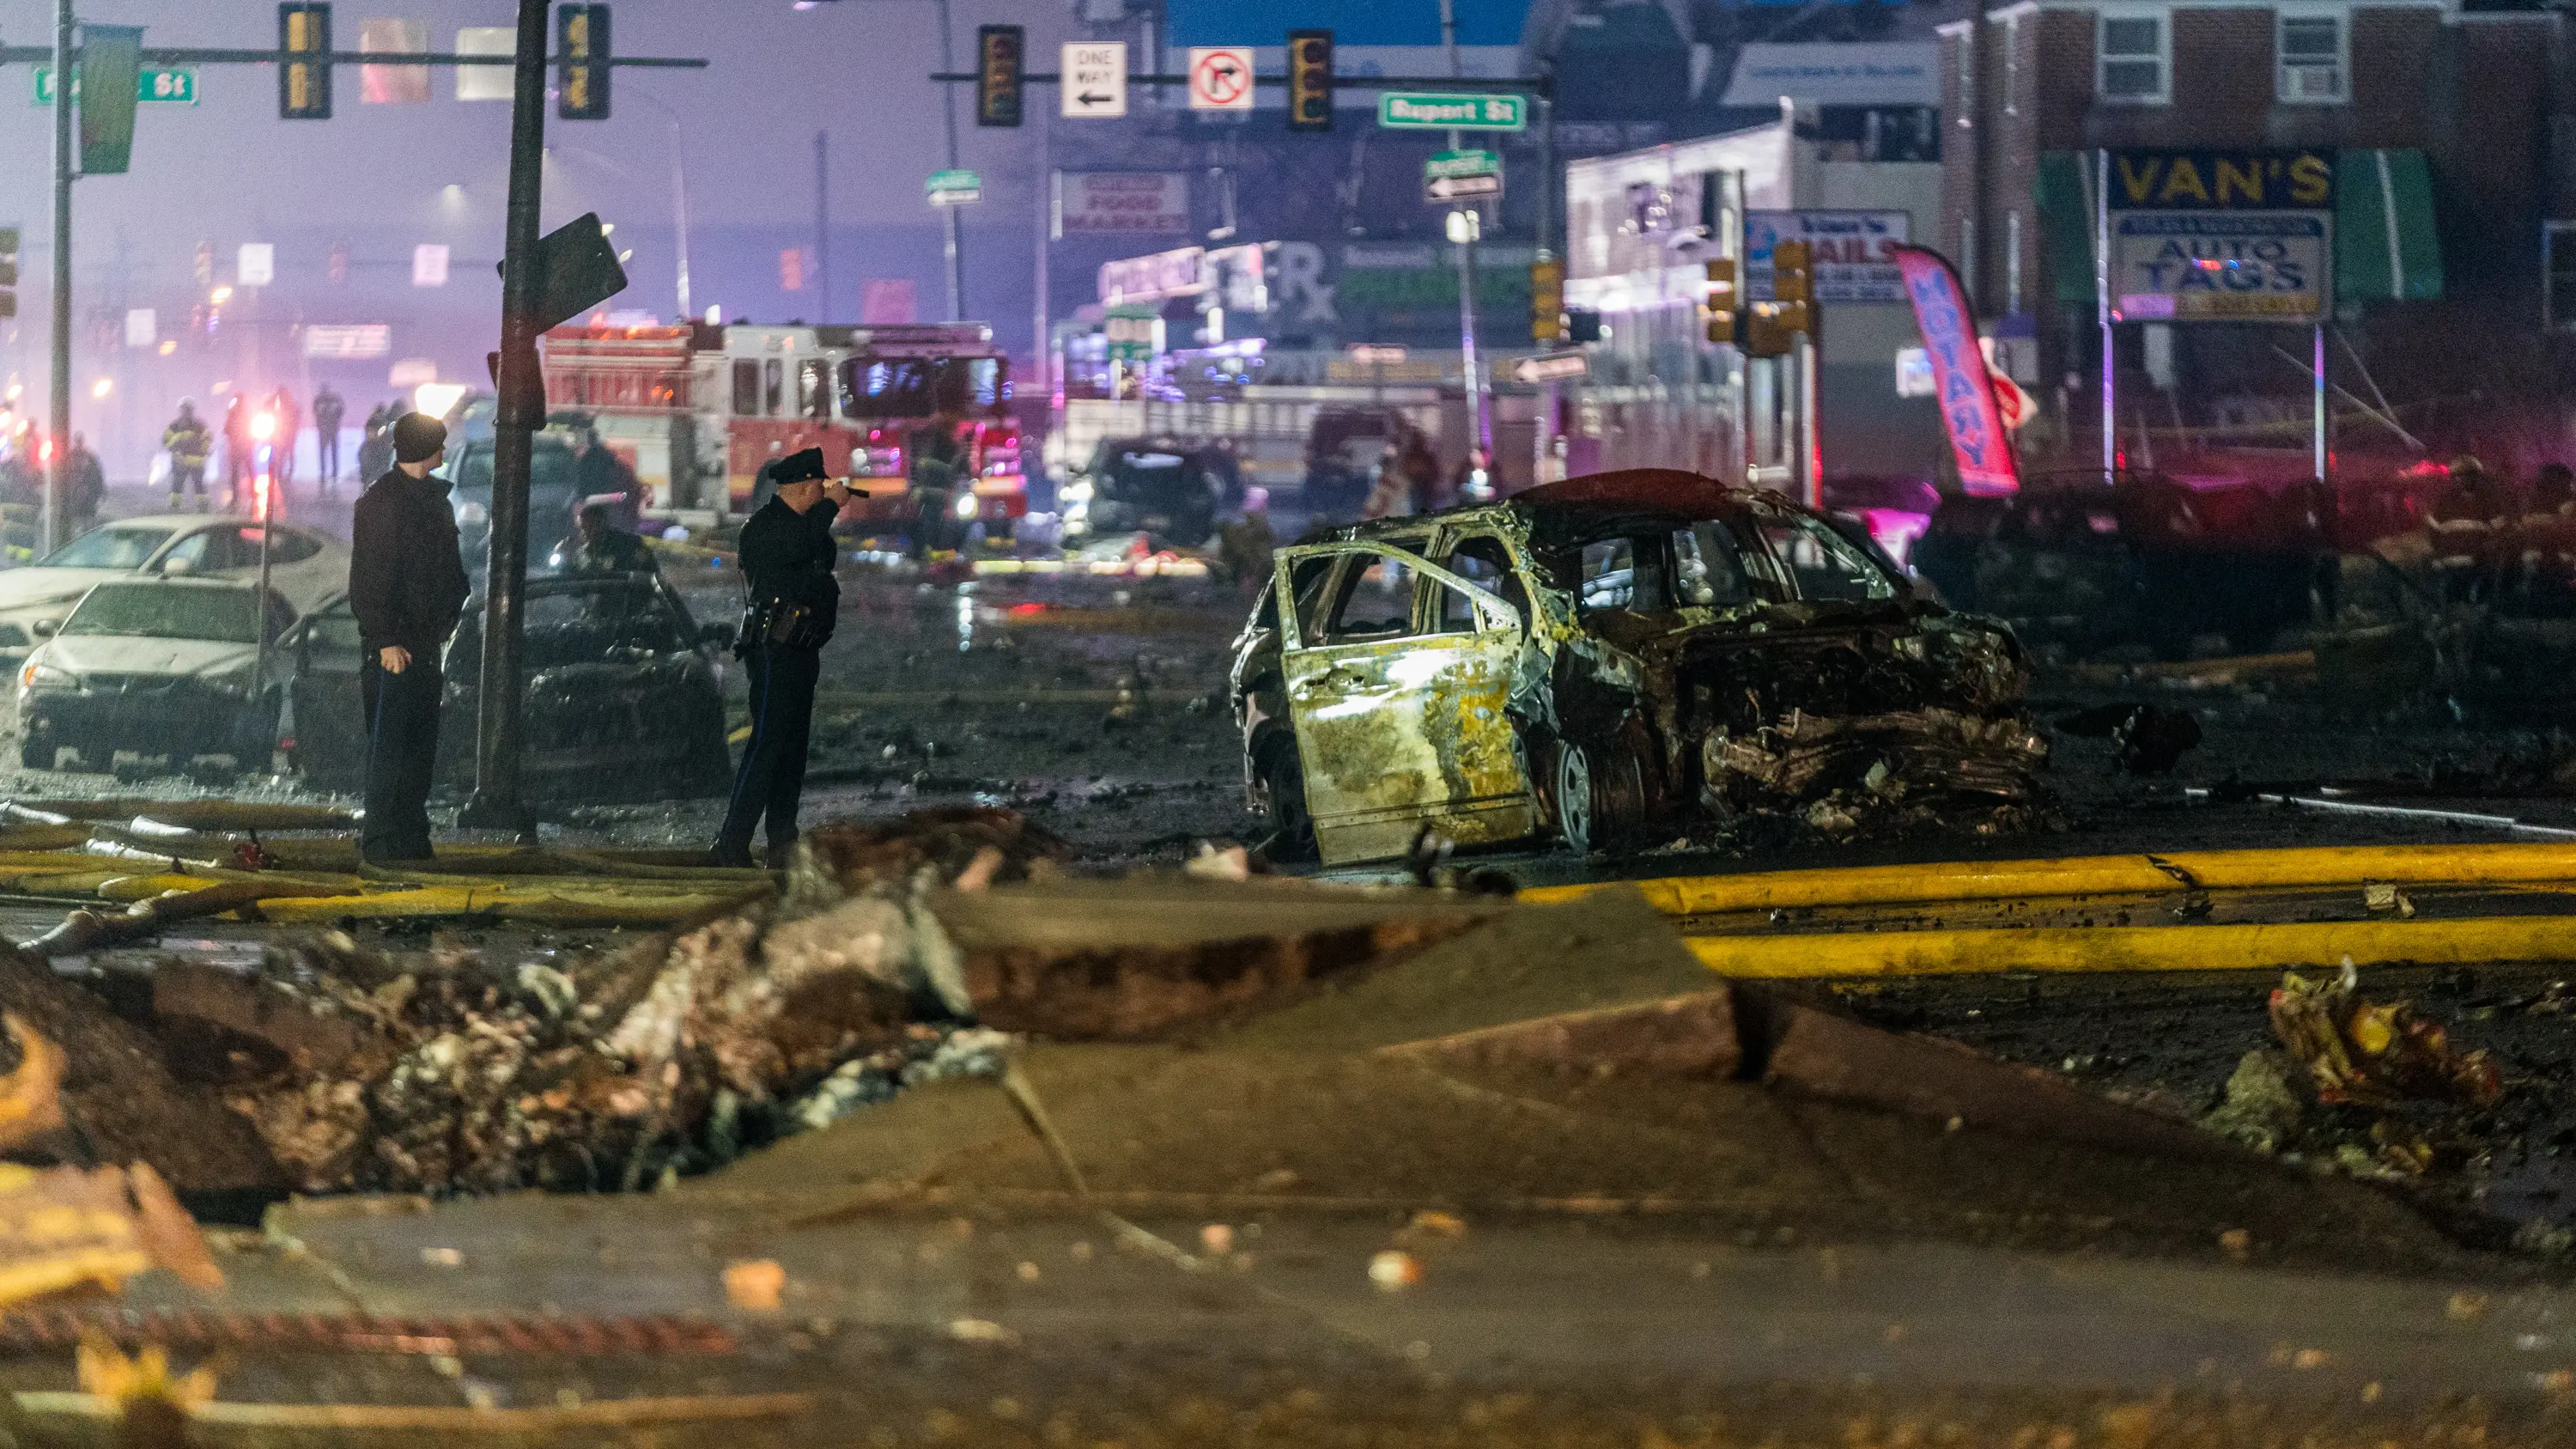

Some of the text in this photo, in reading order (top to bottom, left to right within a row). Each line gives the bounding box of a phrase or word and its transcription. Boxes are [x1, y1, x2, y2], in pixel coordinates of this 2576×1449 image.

[1076, 50, 1113, 65] ONE
[154, 72, 185, 97] St
[1076, 70, 1114, 84] WAY
[1391, 99, 1514, 122] Rupert St
[2118, 155, 2329, 203] VAN'S
[2159, 239, 2287, 260] AUTO
[2138, 261, 2305, 290] TAGS
